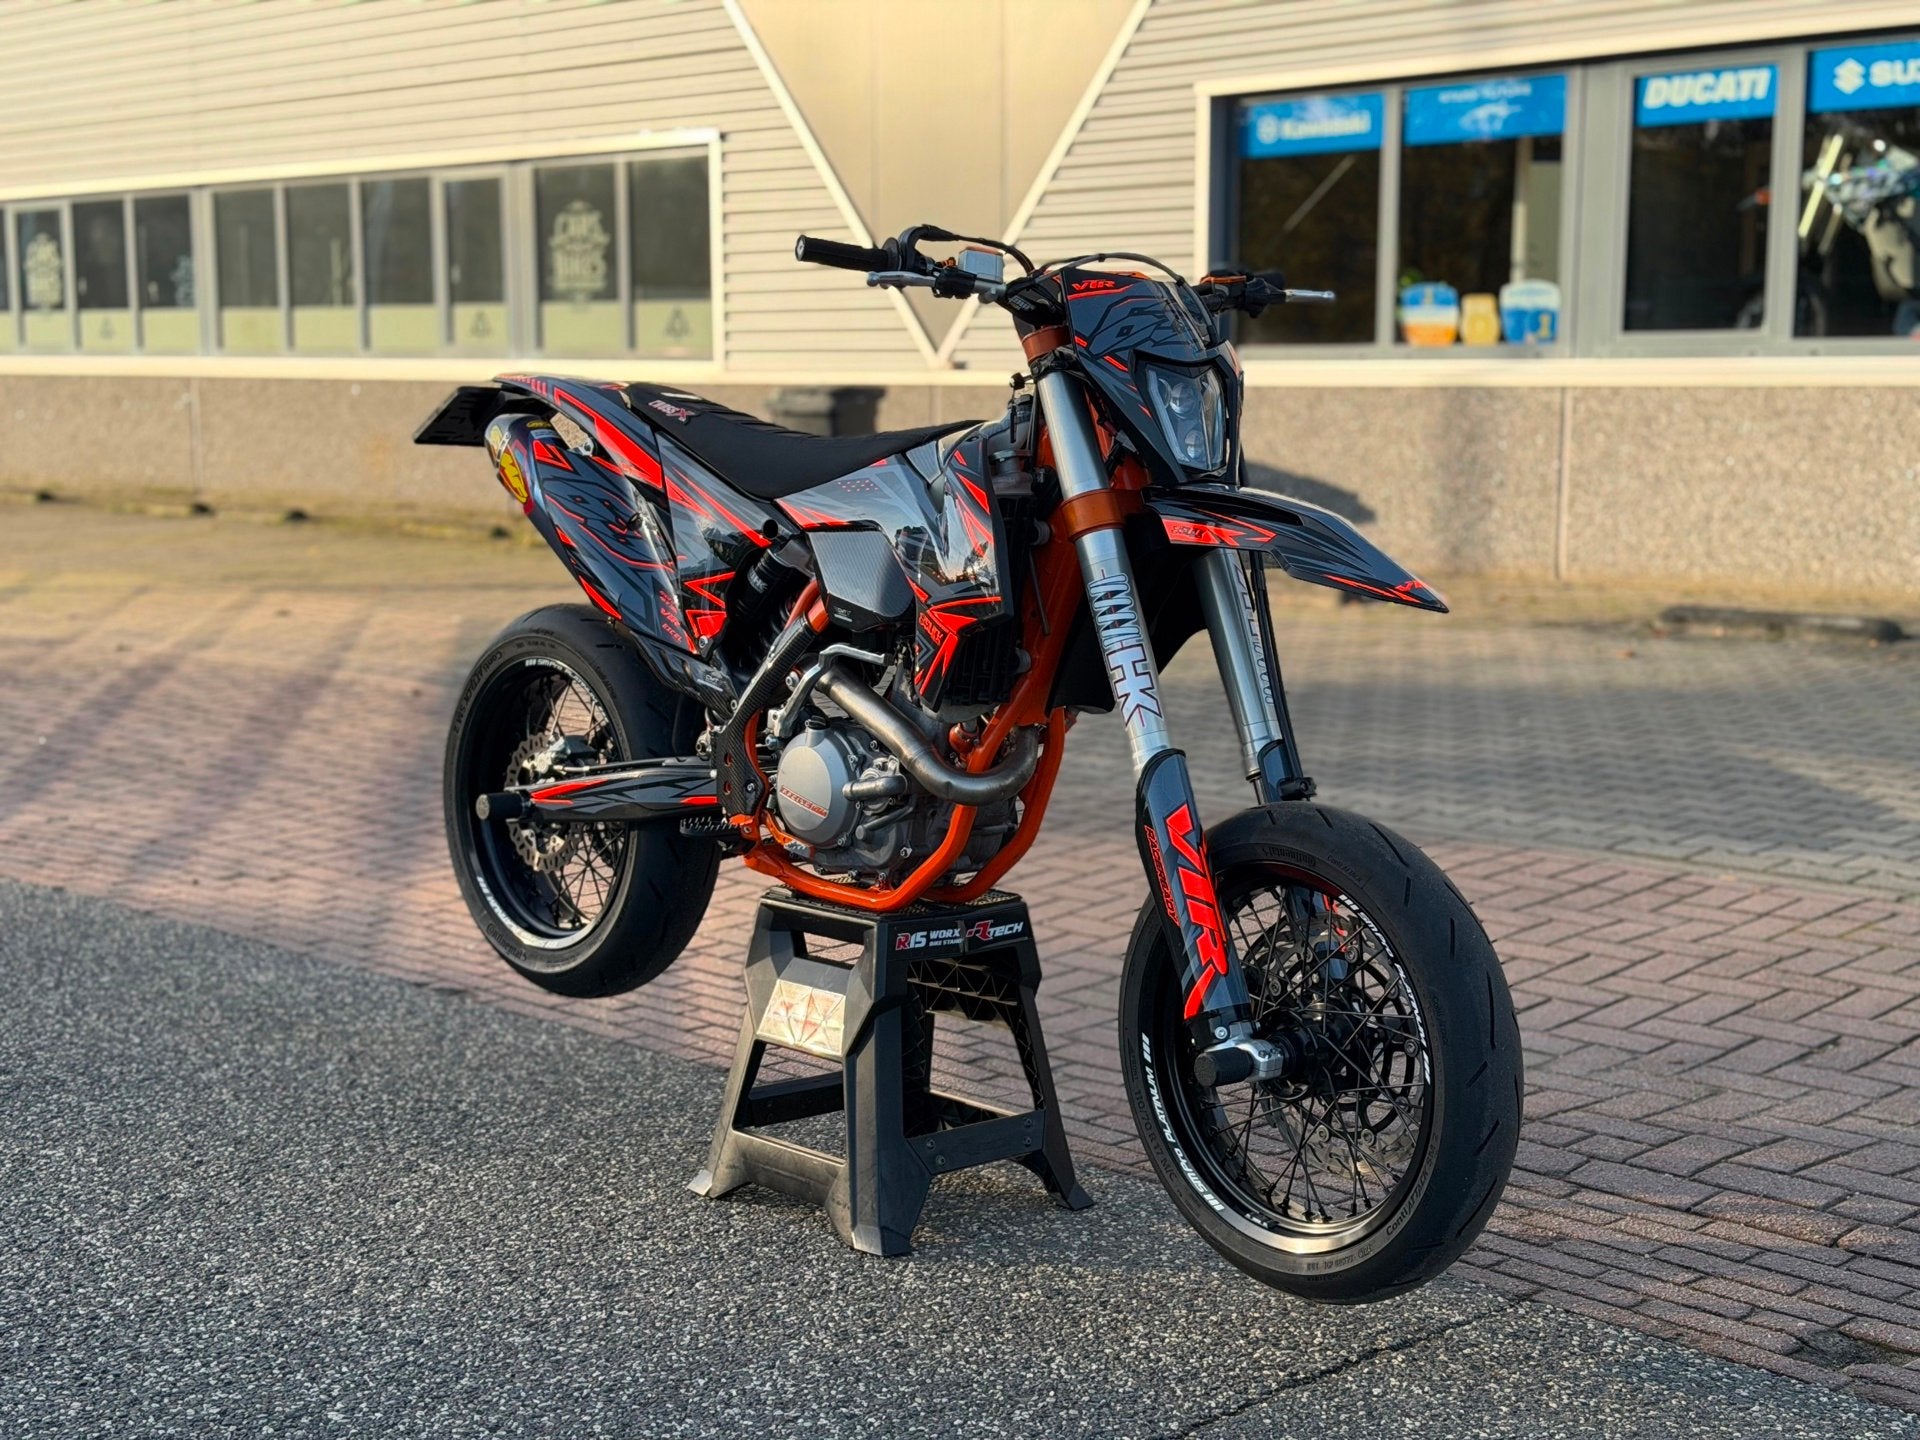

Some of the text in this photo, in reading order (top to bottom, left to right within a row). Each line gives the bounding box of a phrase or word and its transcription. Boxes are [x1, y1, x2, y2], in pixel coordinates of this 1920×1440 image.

[1643, 67, 1771, 110] DUCATI
[895, 931, 927, 951] R15
[929, 928, 961, 939] WORX
[1394, 962, 1427, 1049] PLATINUM
[1144, 1066, 1177, 1143] PLATINUM
